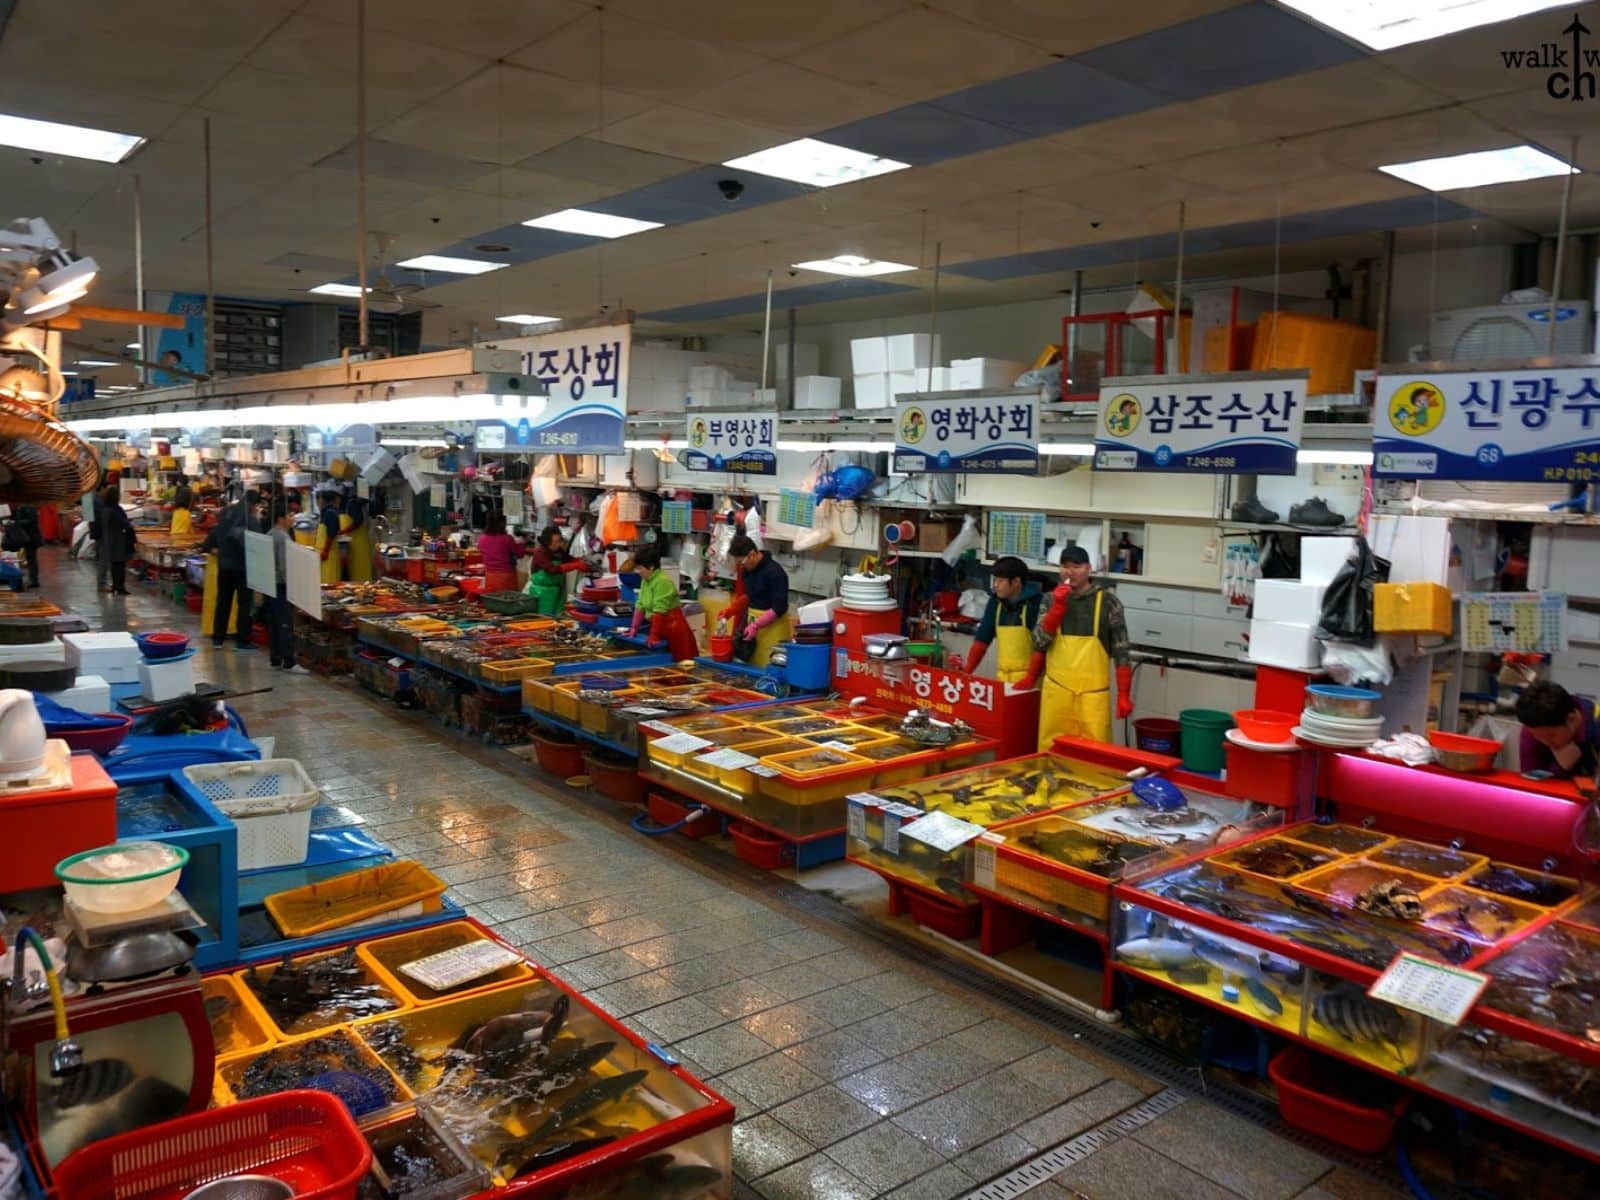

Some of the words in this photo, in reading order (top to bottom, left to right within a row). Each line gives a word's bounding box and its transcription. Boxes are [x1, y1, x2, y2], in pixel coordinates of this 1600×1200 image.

[931, 404, 1033, 441] 영화상회
[1145, 391, 1297, 434] 삼조수산
[1459, 377, 1600, 429] 신광수
[709, 419, 773, 447] 부영상회
